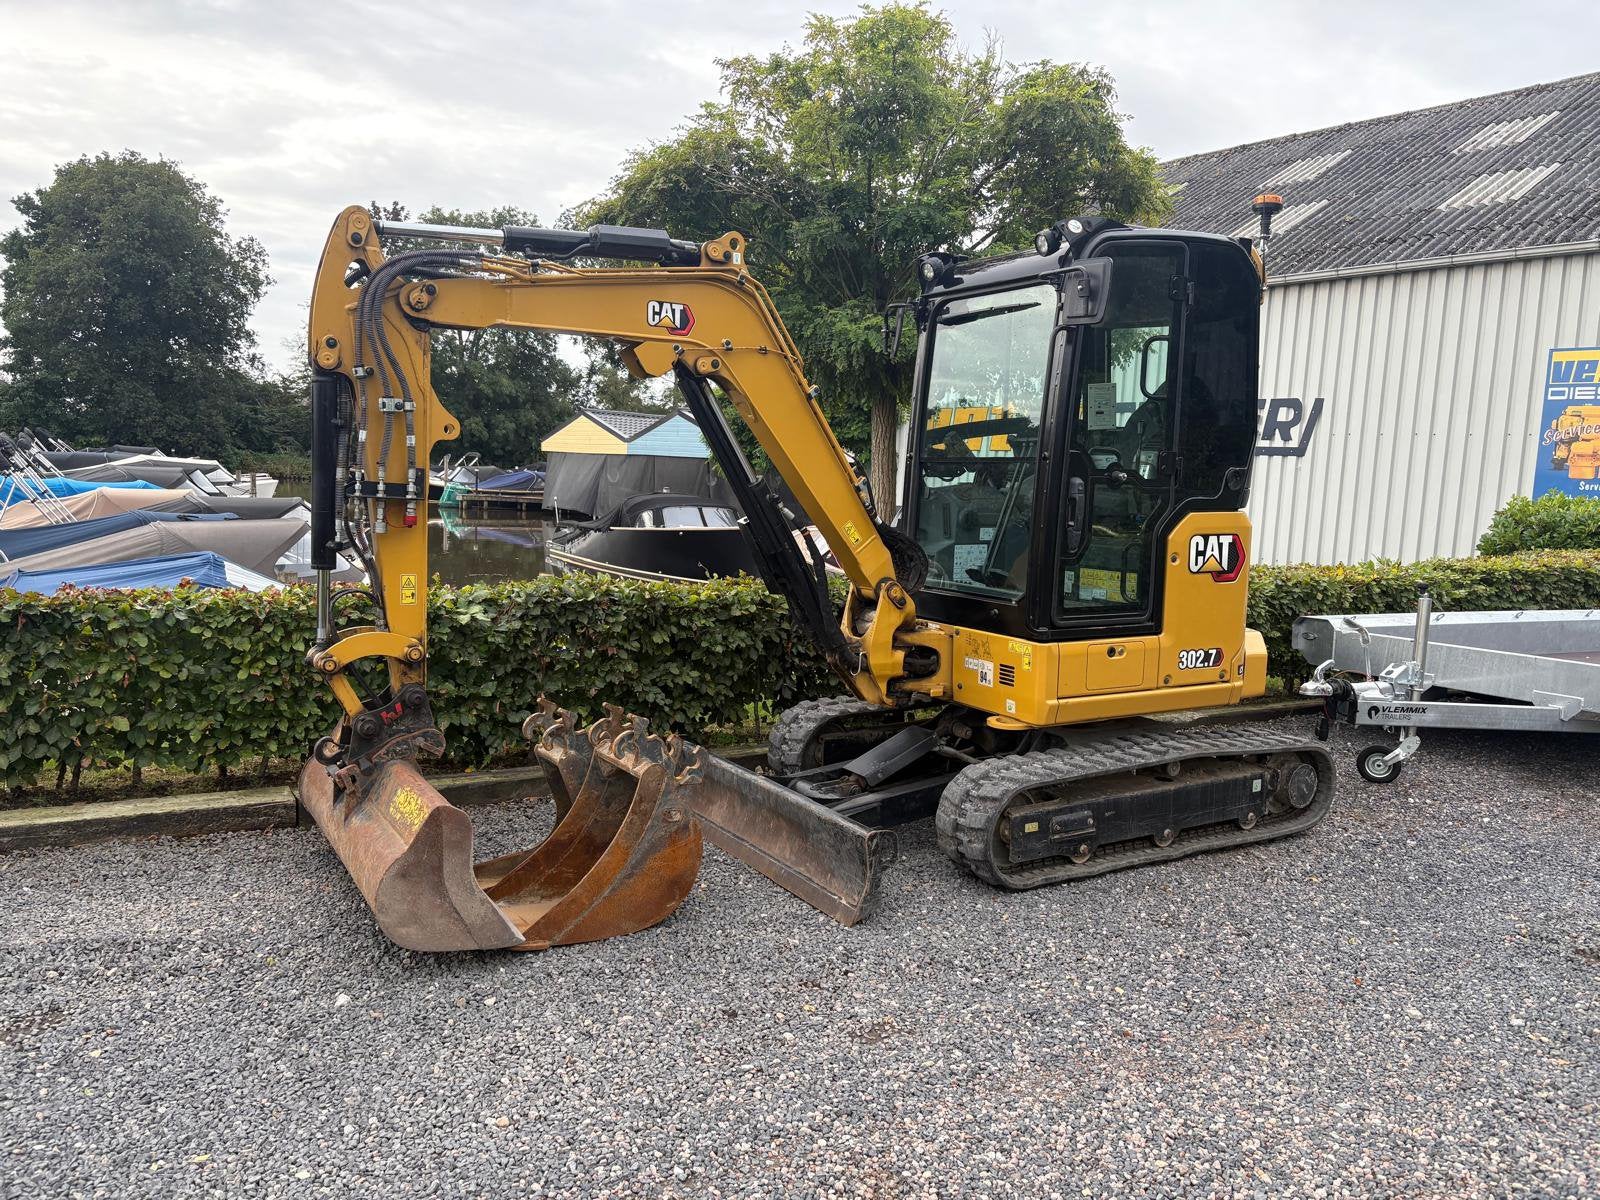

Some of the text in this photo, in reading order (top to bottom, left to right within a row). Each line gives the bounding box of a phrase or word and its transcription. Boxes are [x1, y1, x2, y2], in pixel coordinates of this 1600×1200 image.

[648, 301, 683, 328] CAT
[1548, 387, 1600, 400] DIE
[1190, 535, 1232, 573] CAT
[1178, 649, 1217, 669] 302.7
[980, 671, 987, 683] 94
[1382, 706, 1427, 714] VLEMMIX
